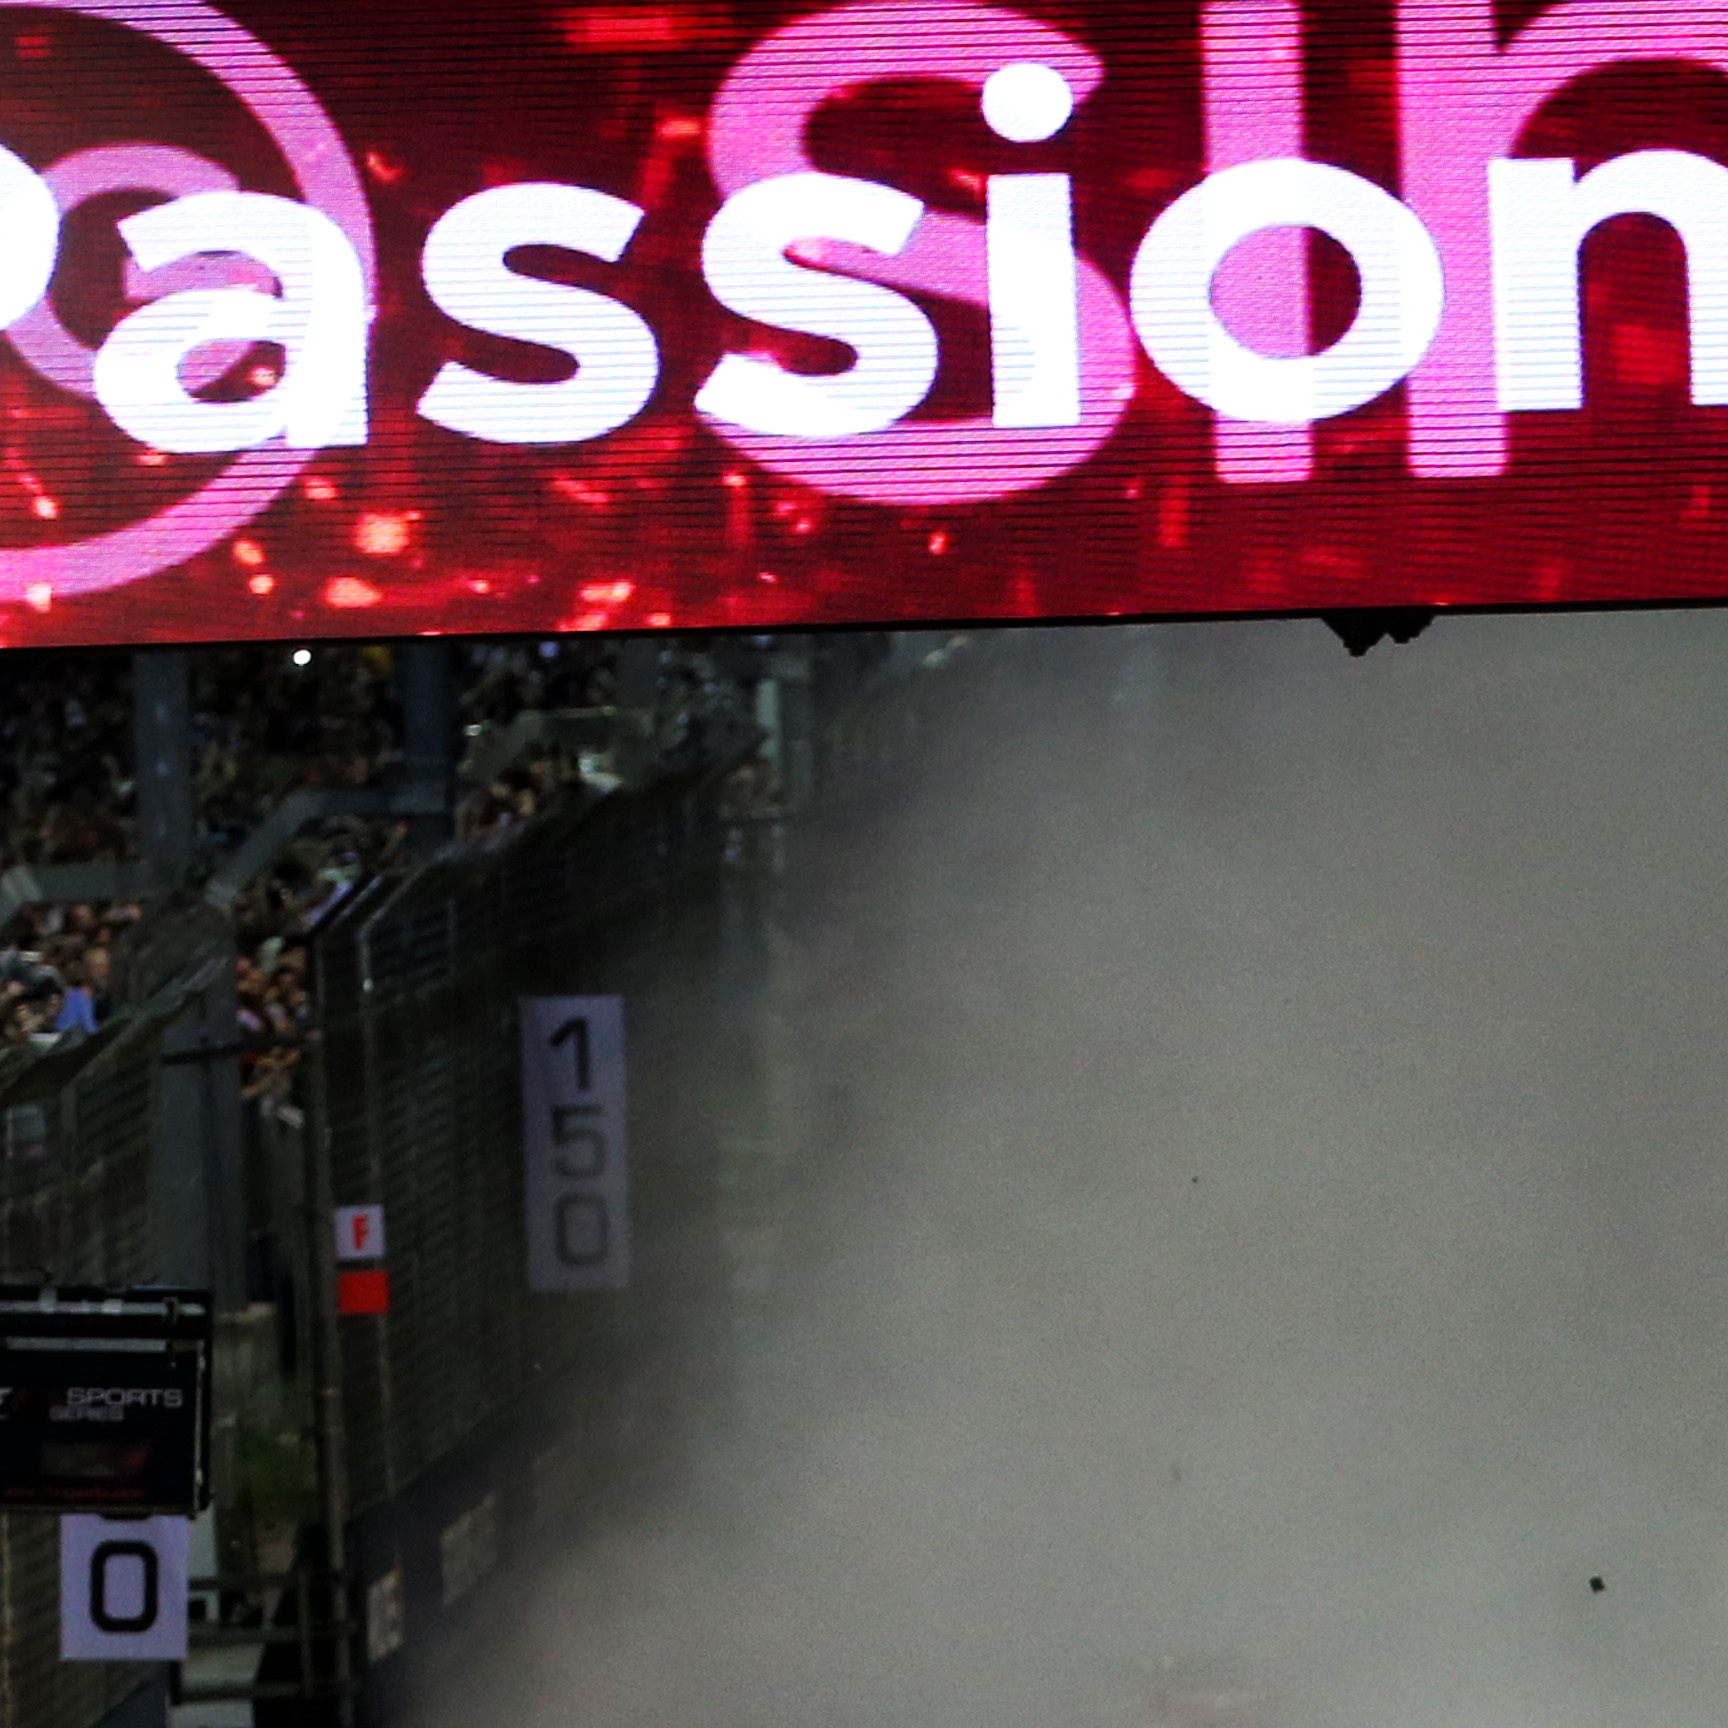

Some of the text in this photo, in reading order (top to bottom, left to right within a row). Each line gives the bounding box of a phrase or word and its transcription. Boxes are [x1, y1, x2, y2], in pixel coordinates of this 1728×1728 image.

[352, 1214, 370, 1251] F
[66, 1386, 184, 1409] SPORTS
[90, 1540, 158, 1633] 0
